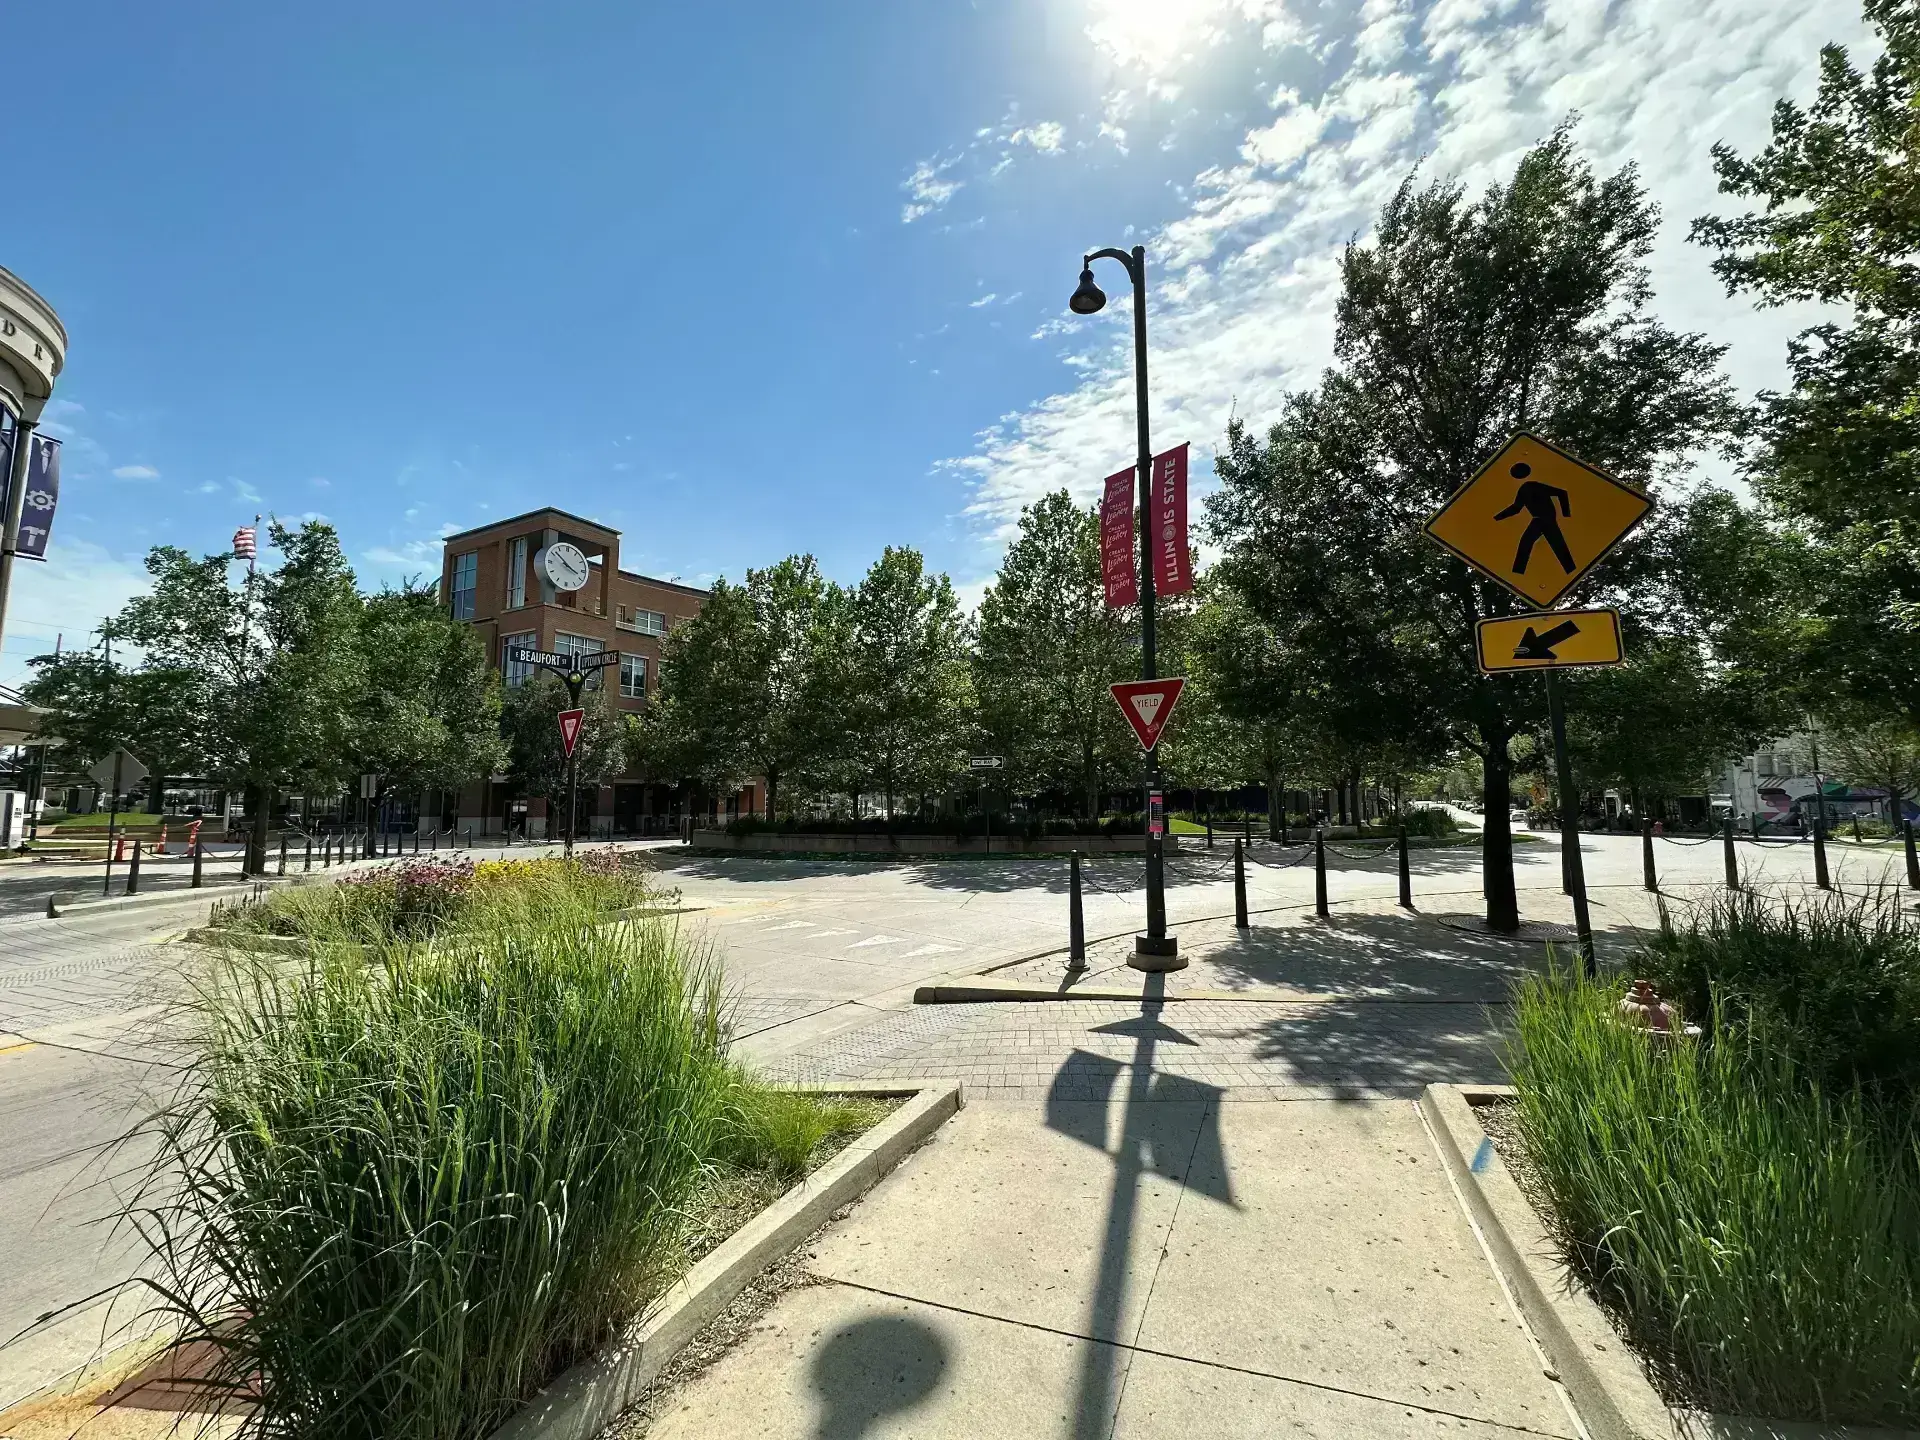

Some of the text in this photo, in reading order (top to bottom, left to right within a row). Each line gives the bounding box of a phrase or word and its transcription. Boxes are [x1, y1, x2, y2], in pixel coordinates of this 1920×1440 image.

[1163, 457, 1176, 505] STATE
[520, 649, 560, 666] BEAUFORT
[581, 652, 617, 668] UPTOWN CIRCLE
[1136, 698, 1158, 708] YIELD
